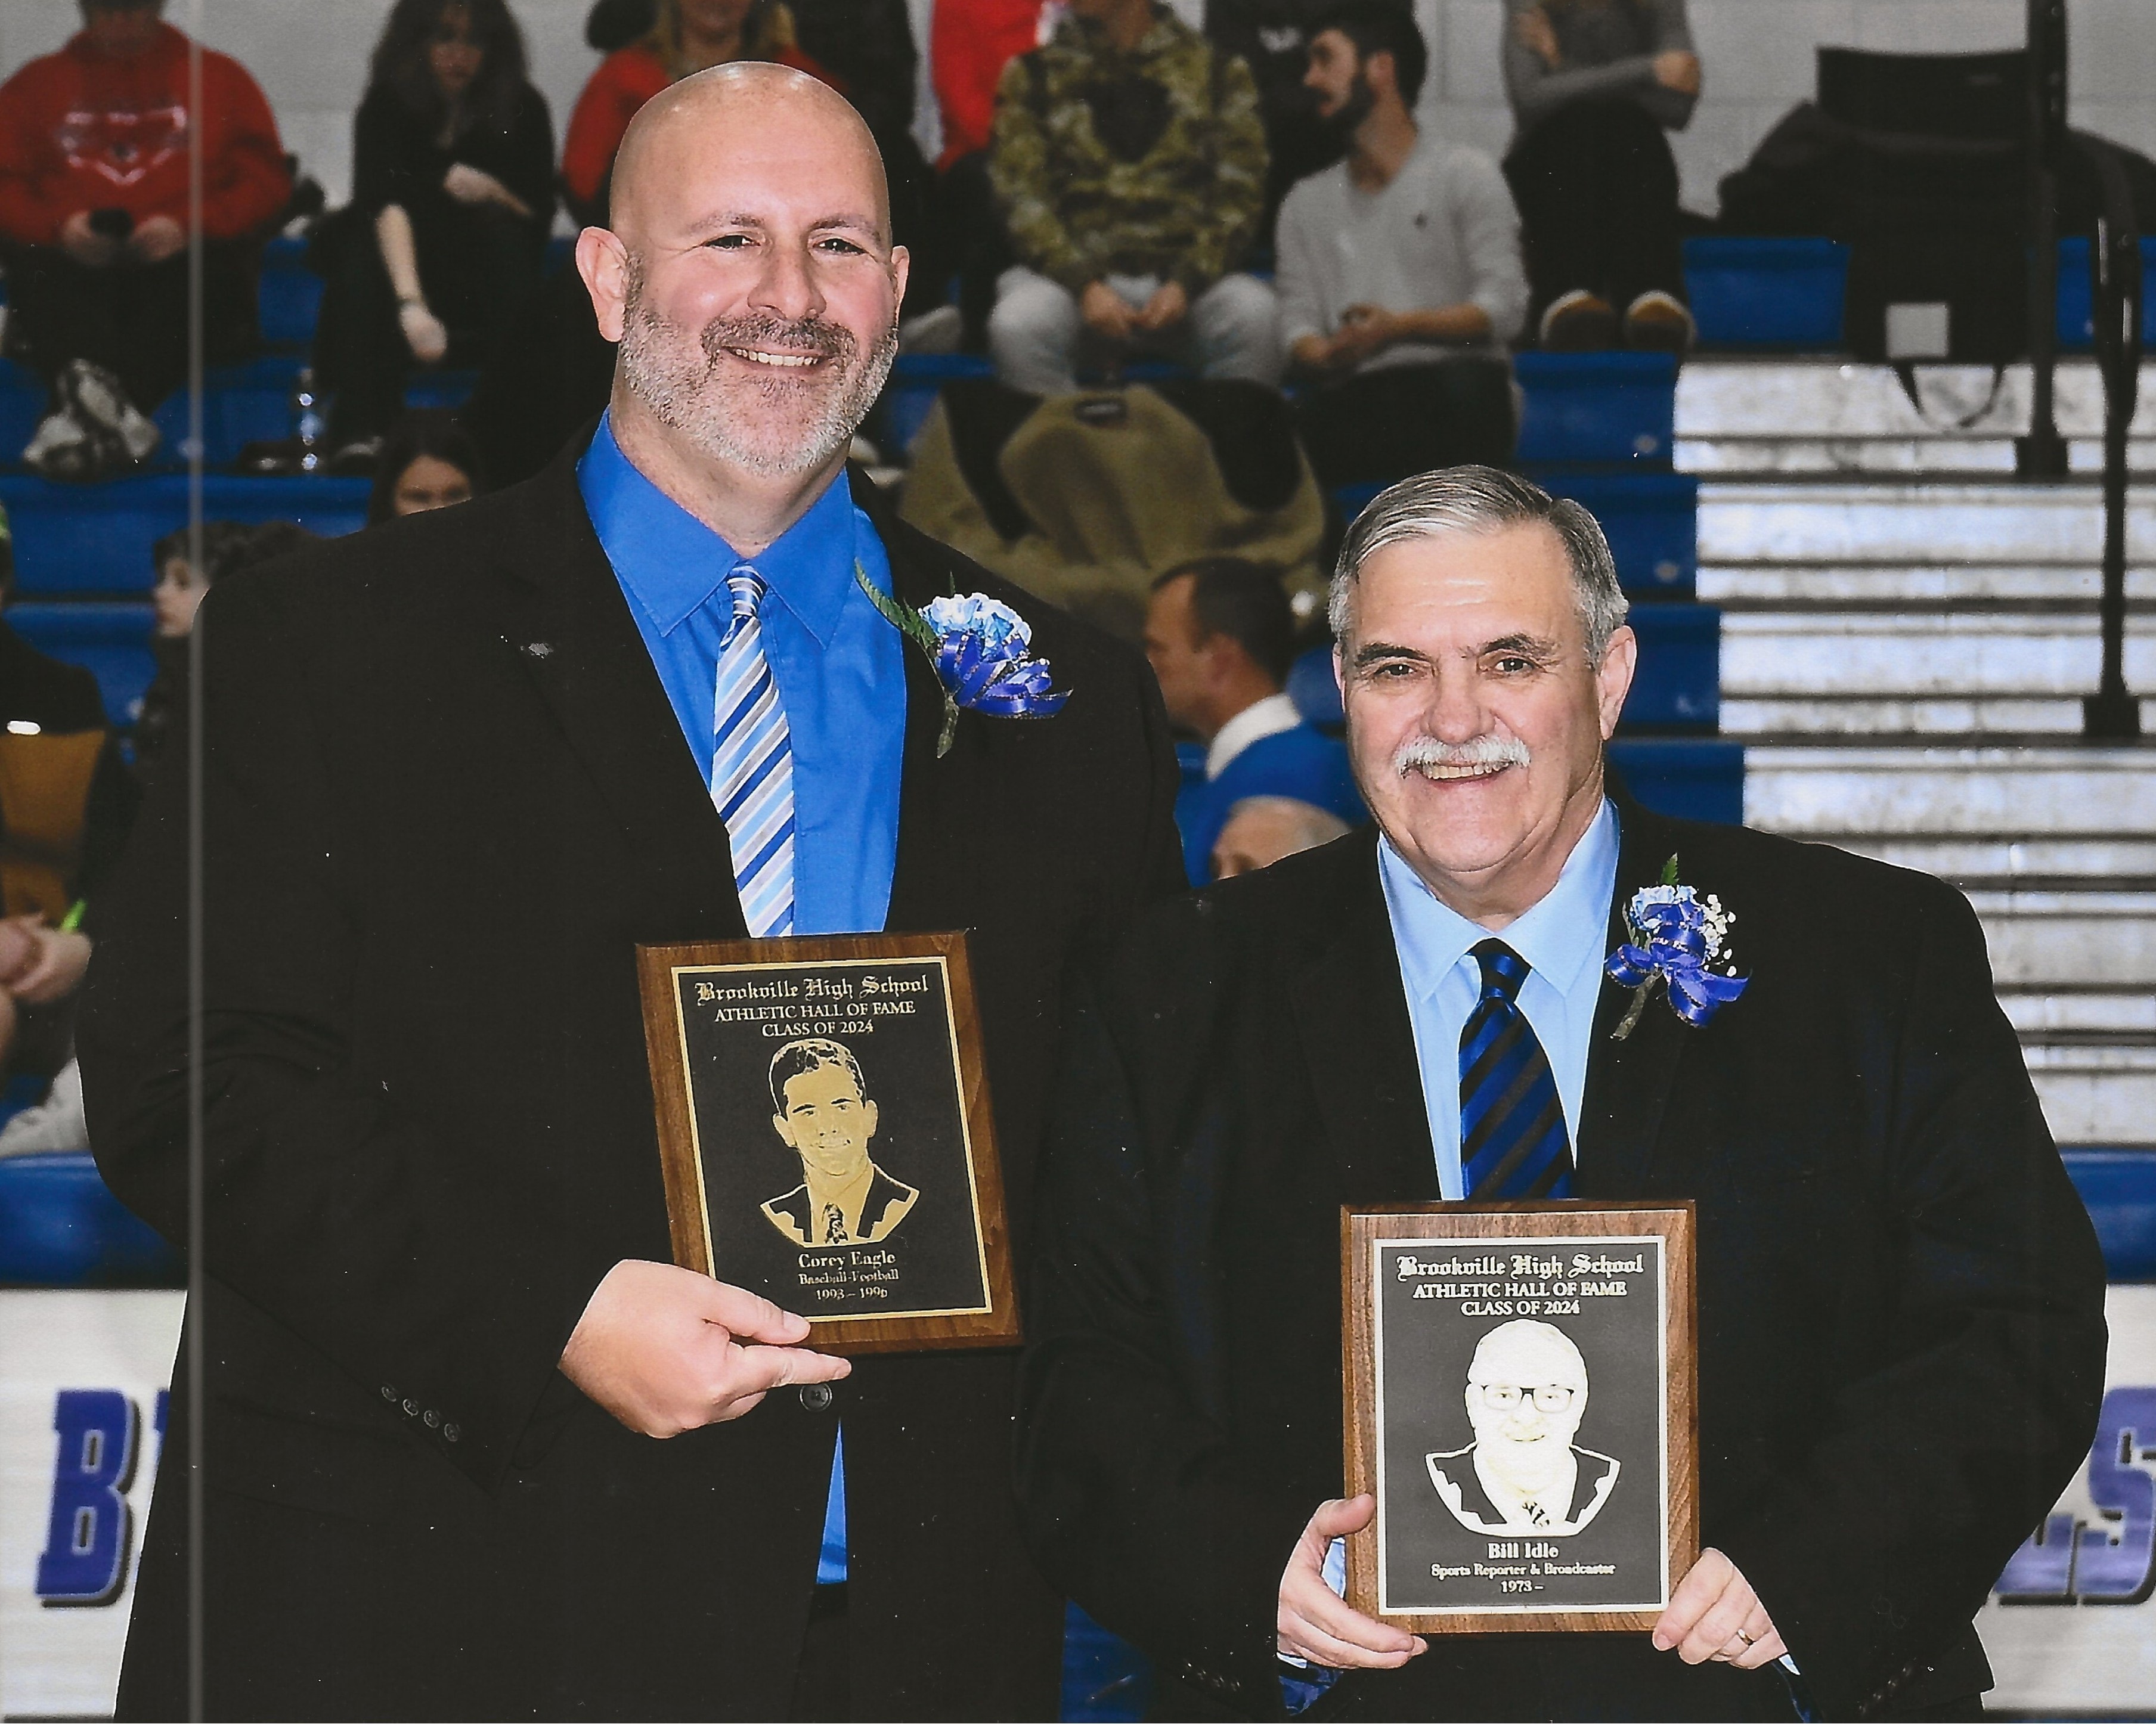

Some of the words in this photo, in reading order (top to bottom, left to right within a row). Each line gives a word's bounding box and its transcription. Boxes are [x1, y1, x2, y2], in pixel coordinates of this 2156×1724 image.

[694, 980, 799, 1006] Brookville
[803, 978, 853, 1000] High
[859, 974, 929, 999] School
[715, 1006, 796, 1022] ATHLETIC
[800, 1003, 843, 1018] HALL
[846, 1002, 869, 1016] OF
[872, 1000, 916, 1015] FAME
[762, 1023, 810, 1037] CLASS
[814, 1022, 836, 1035] OF
[840, 1019, 874, 1034] 2024
[1396, 1255, 1506, 1282] Brookville
[1510, 1254, 1563, 1280] High
[1568, 1254, 1644, 1278] School
[1412, 1283, 1501, 1299] ATHLETIC
[1505, 1283, 1551, 1297] HALL
[1553, 1282, 1577, 1297] OF
[1580, 1281, 1627, 1297] FAME
[1461, 1301, 1513, 1316] CLASS
[1516, 1301, 1541, 1315] OF
[1544, 1300, 1580, 1315] 2024
[1488, 1543, 1519, 1559] Bill
[1525, 1543, 1559, 1558] Idle
[1431, 1564, 1471, 1580] Sports
[1473, 1563, 1527, 1579] Reporter
[1530, 1563, 1541, 1575] &
[1544, 1562, 1616, 1575] Broadcaster
[1501, 1580, 1532, 1592] 1973
